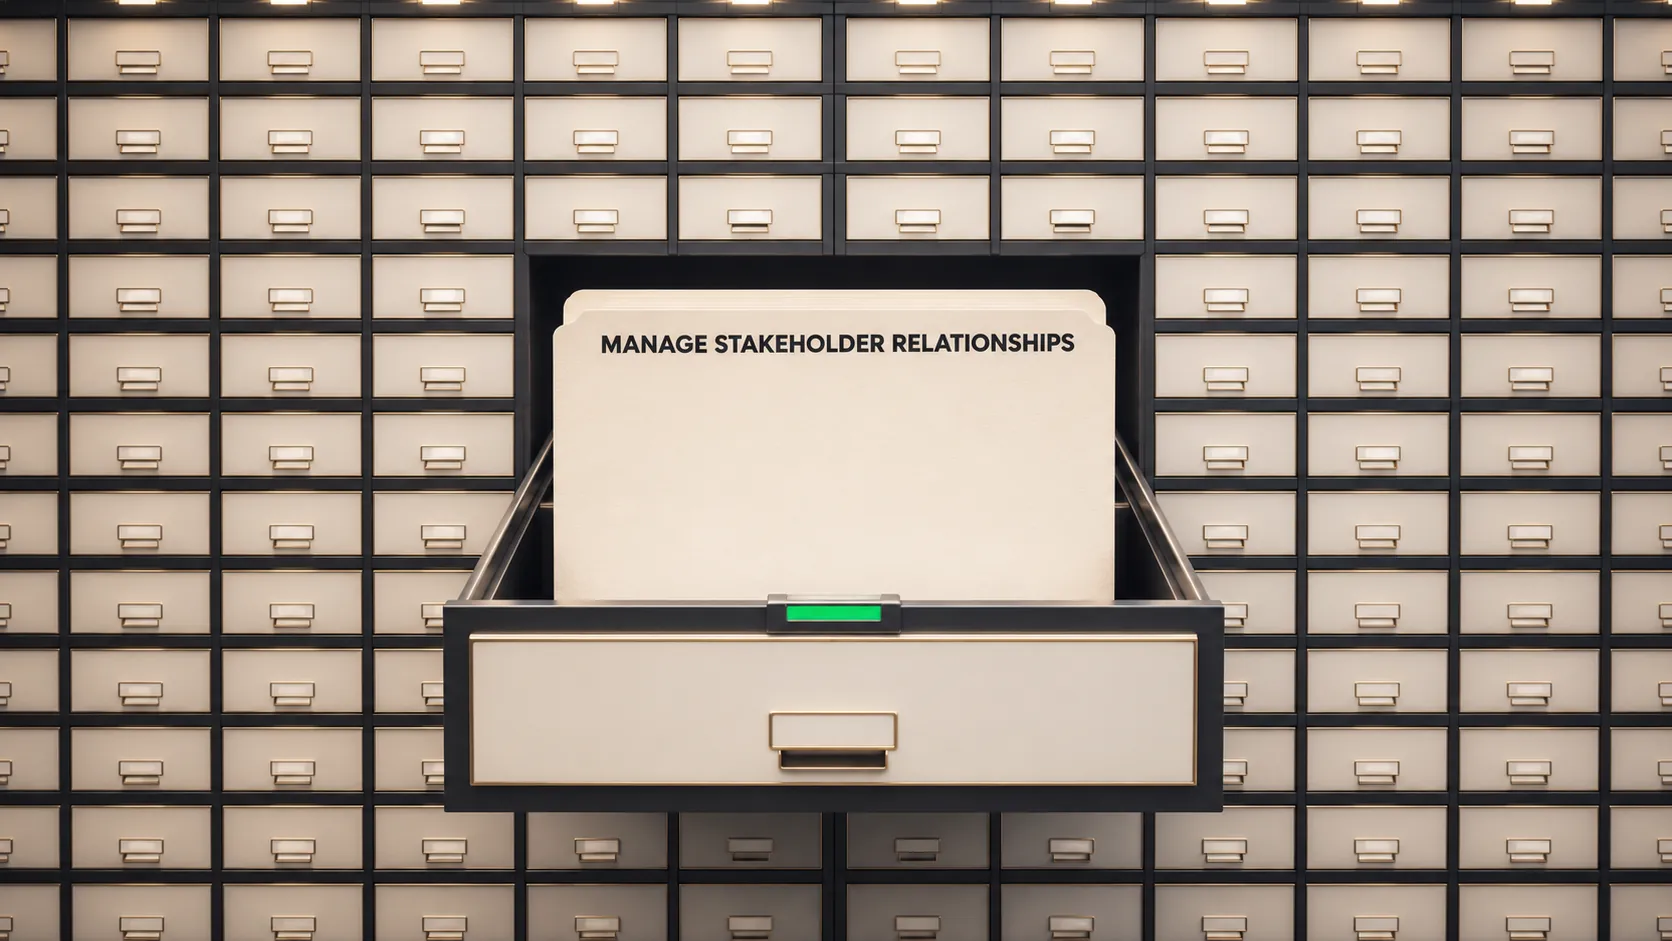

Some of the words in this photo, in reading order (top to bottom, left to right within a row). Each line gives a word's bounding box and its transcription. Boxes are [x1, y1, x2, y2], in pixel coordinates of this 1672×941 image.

[601, 335, 708, 354] MANAGE
[714, 334, 885, 354] STAKEHOLDER
[892, 333, 1075, 353] RELATIONSHIPS
